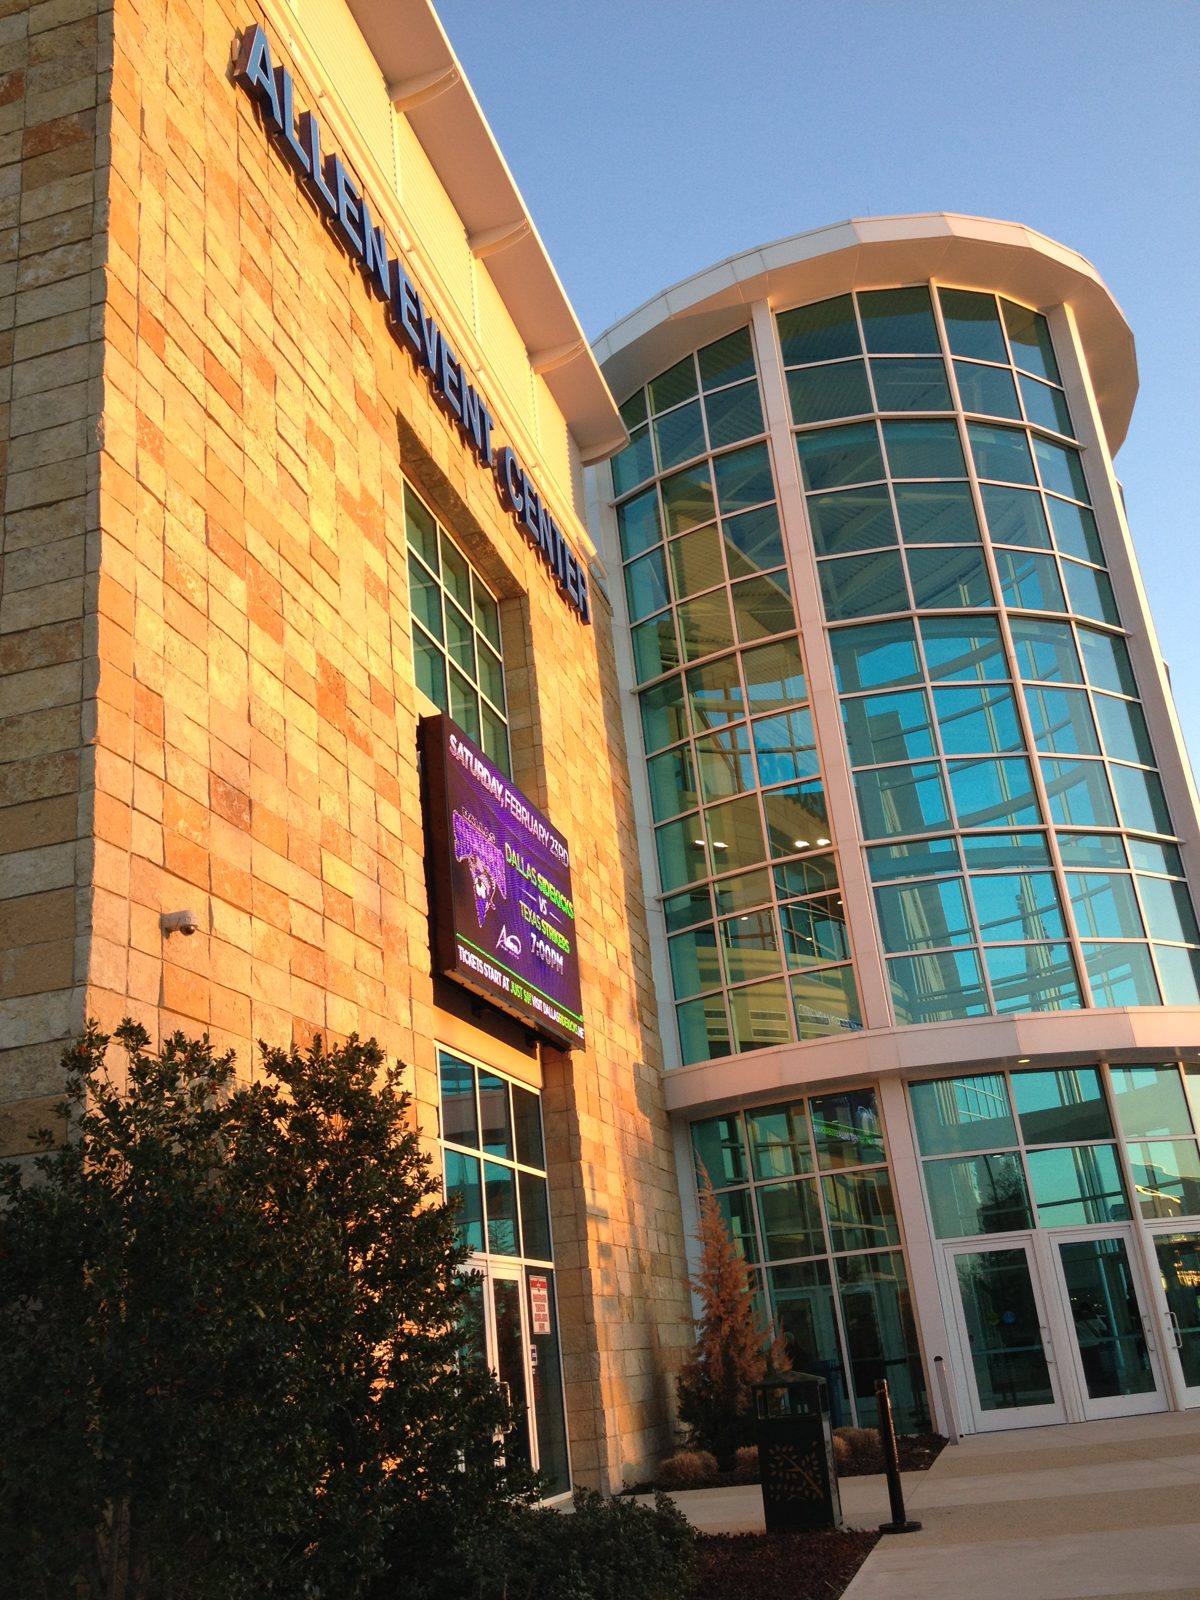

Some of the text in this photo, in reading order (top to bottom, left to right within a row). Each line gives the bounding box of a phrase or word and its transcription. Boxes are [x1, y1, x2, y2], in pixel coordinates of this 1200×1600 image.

[236, 23, 591, 624] ALLEN EVENT CENTER
[449, 734, 504, 807] SATURDAY,
[505, 788, 550, 846] FEBRUARY
[549, 836, 570, 868] 23RD
[505, 842, 538, 887] DALLAS
[537, 872, 574, 919] SIDEKICKS
[519, 900, 542, 931] TEXAS
[538, 895, 548, 915] VS
[457, 944, 484, 975] TICKETS
[483, 962, 503, 987] START
[502, 975, 510, 992] AT
[530, 932, 564, 975] 7:00PM
